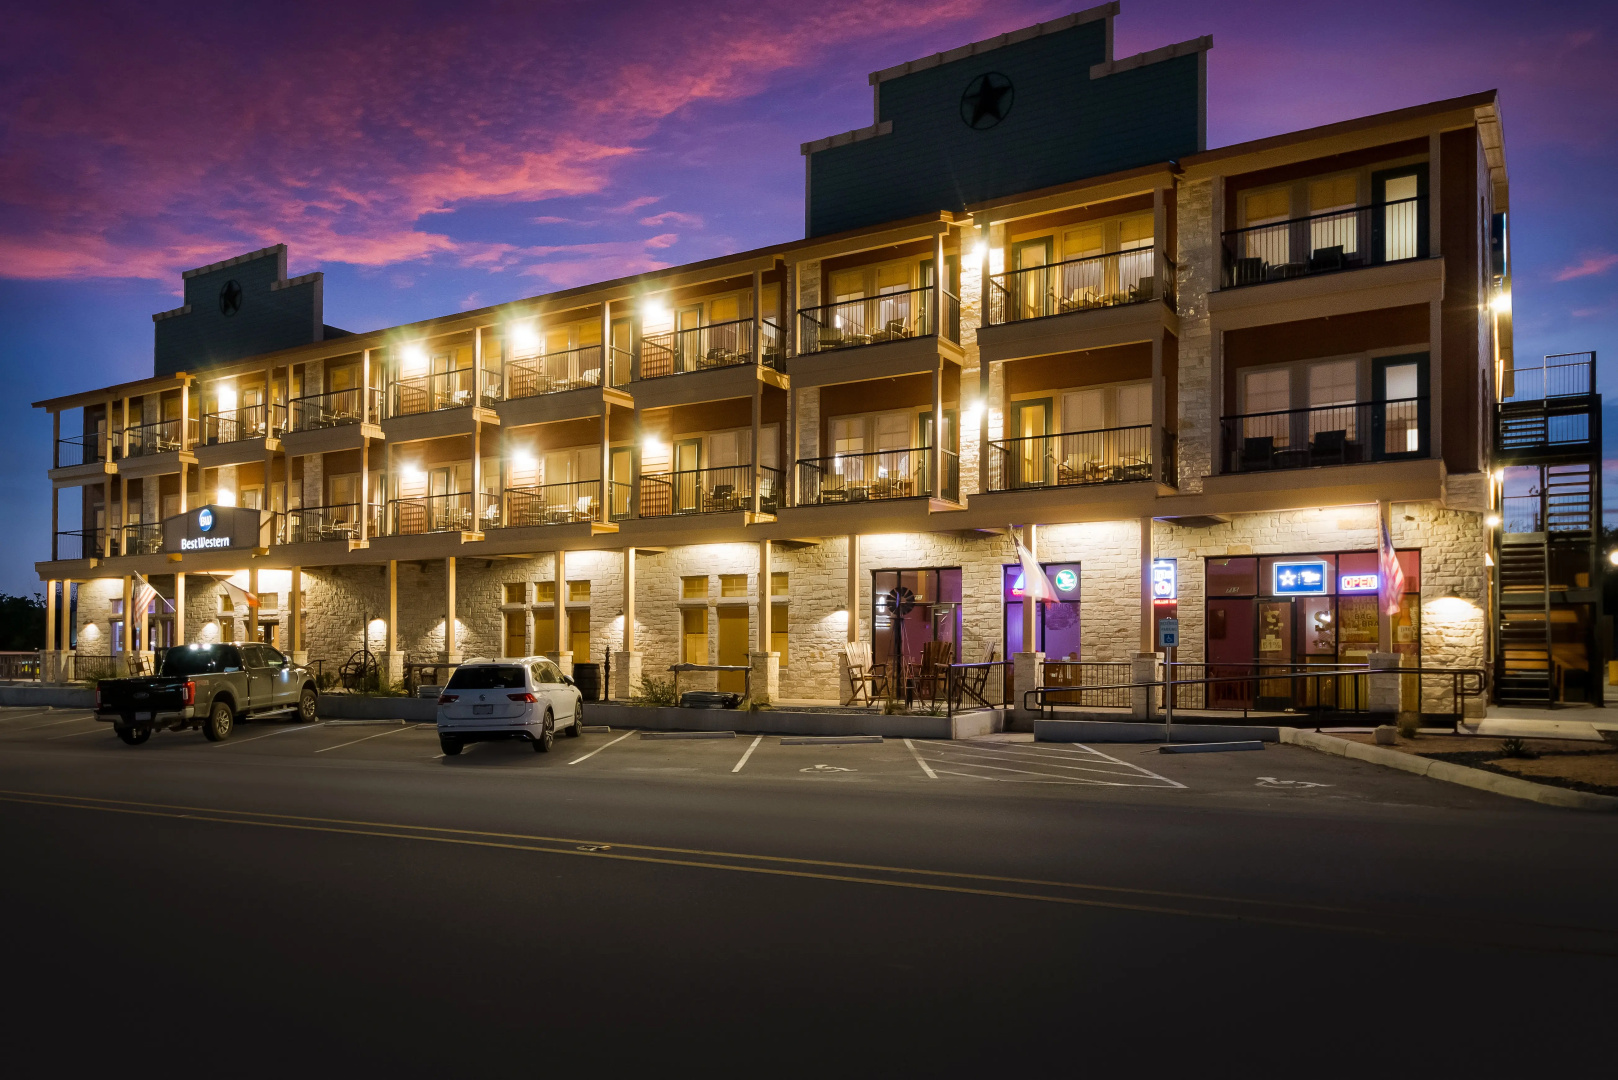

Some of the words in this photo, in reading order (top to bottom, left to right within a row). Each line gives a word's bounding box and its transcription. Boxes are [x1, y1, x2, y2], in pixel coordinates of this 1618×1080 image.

[181, 539, 198, 550] Best
[198, 537, 229, 548] Western
[1345, 578, 1375, 588] OPEN
[1262, 641, 1282, 649] 51%
